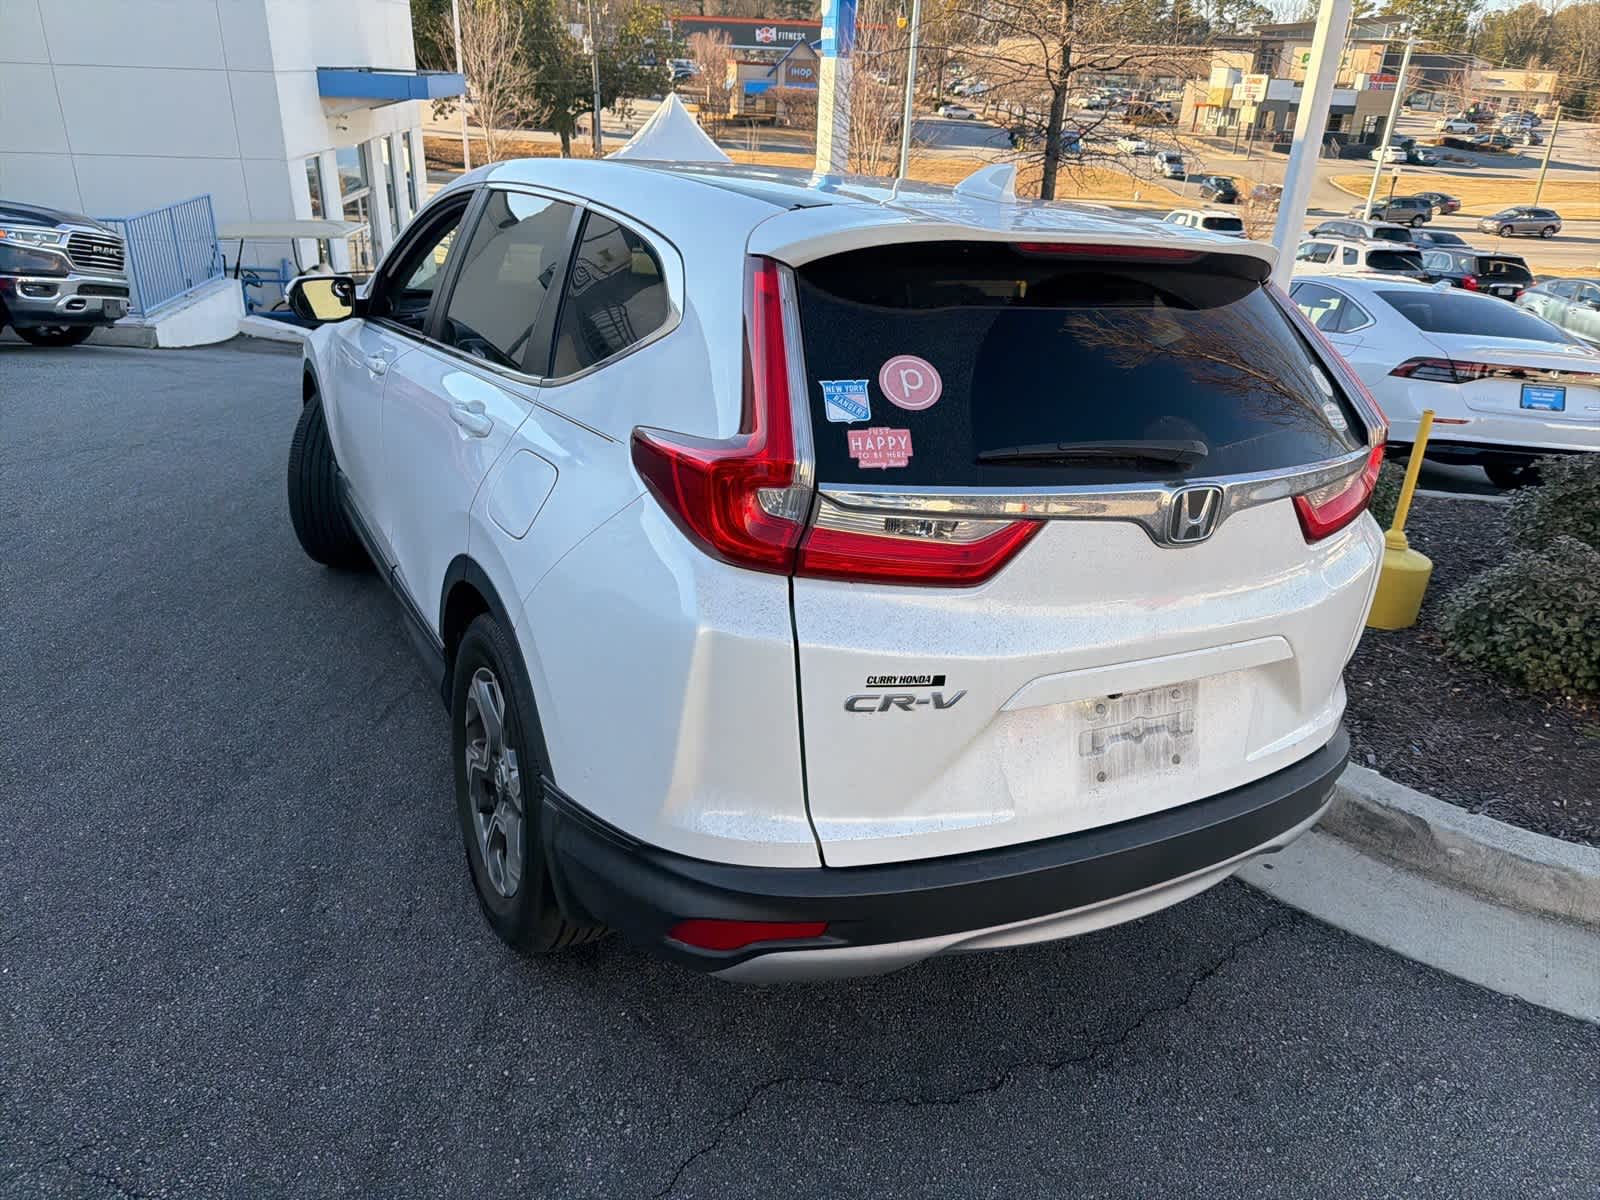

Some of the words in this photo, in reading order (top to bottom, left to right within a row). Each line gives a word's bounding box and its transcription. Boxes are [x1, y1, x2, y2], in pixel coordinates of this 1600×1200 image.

[778, 31, 806, 40] FITNESS
[825, 384, 843, 393] NEW
[845, 384, 865, 392] YORK
[833, 394, 867, 418] RANGERS
[868, 427, 890, 436] JUST
[851, 435, 907, 451] HAPPY
[858, 451, 870, 460] TO
[873, 451, 882, 459] BE
[887, 450, 905, 458] HERE
[866, 675, 899, 685] CURRY
[899, 675, 931, 684] HONDA
[844, 689, 968, 712] CR-V
